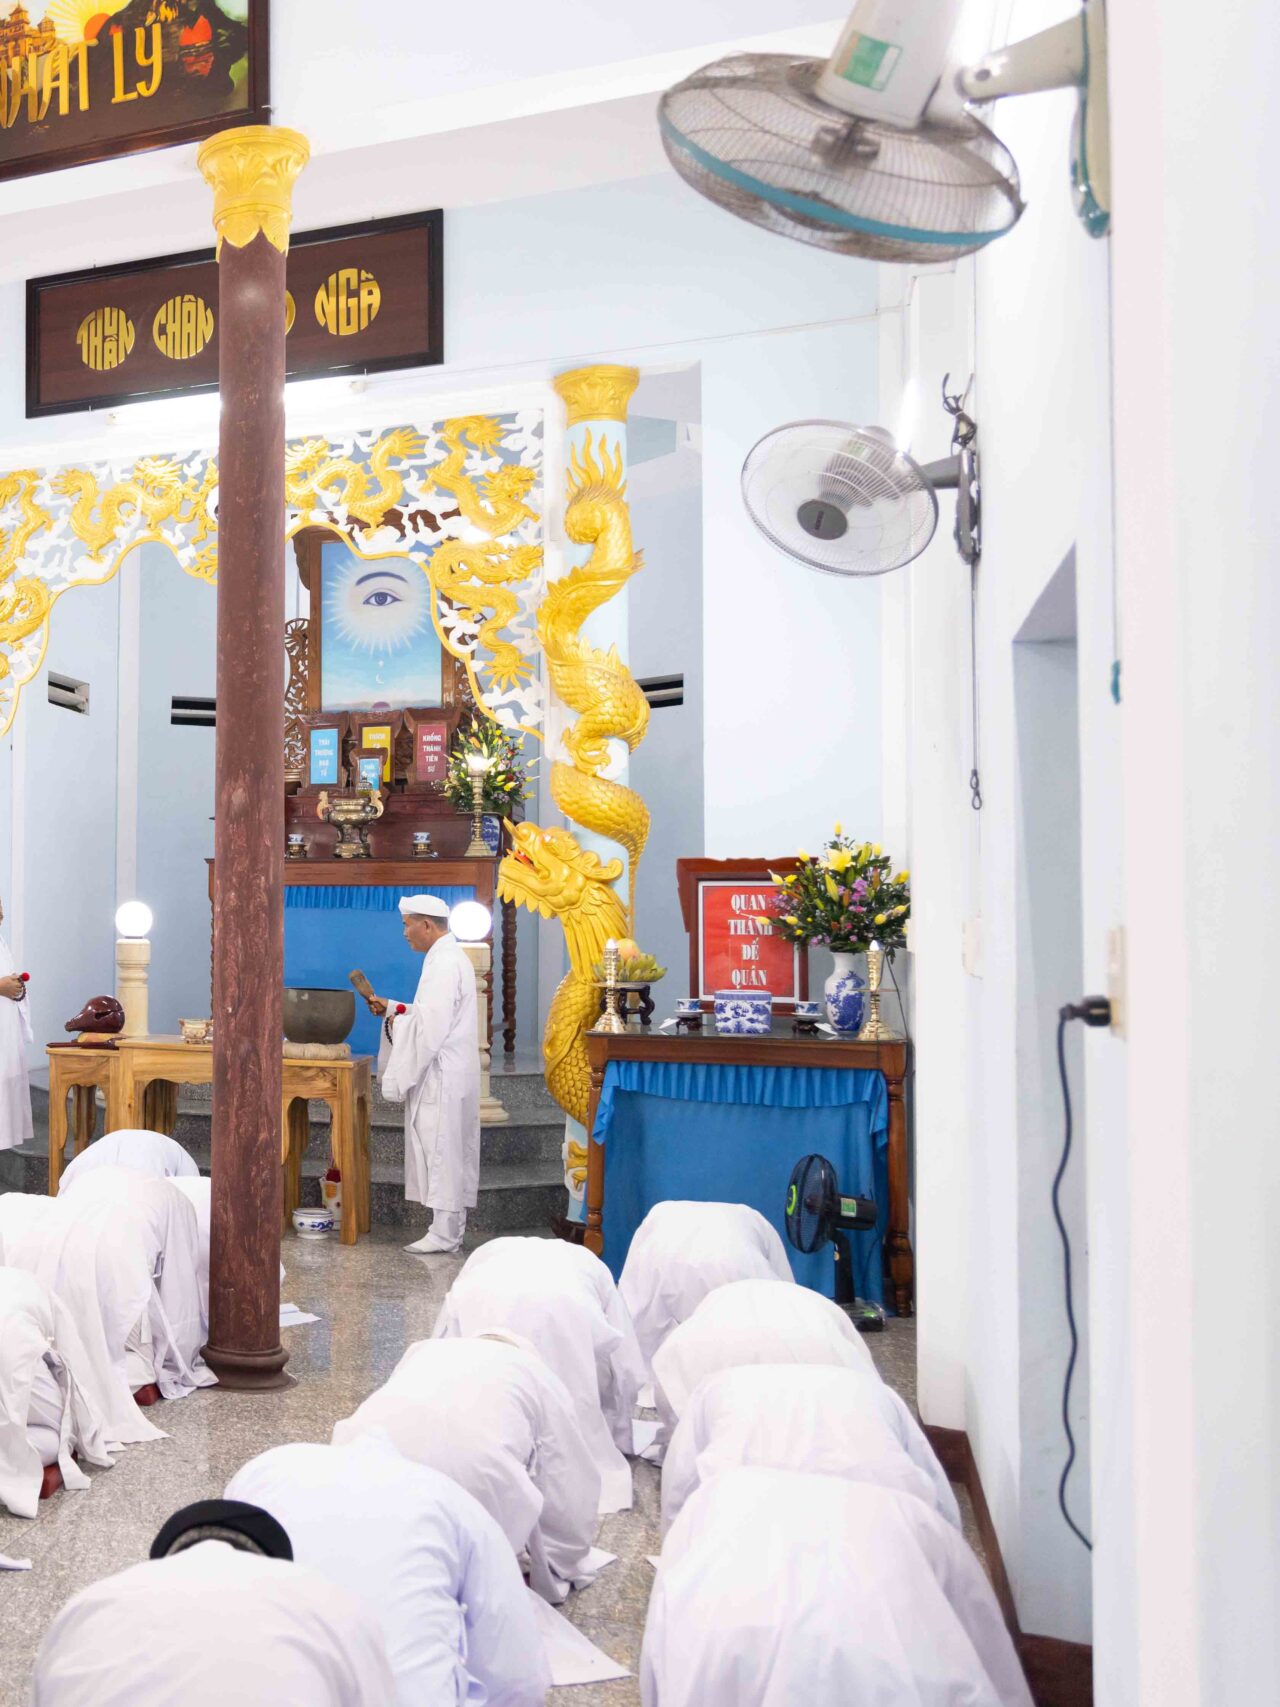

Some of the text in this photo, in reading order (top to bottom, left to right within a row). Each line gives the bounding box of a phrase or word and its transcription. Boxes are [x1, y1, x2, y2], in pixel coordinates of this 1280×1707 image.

[111, 11, 163, 104] LÝ
[152, 294, 215, 360] CHÂN
[731, 894, 766, 914] QUAN
